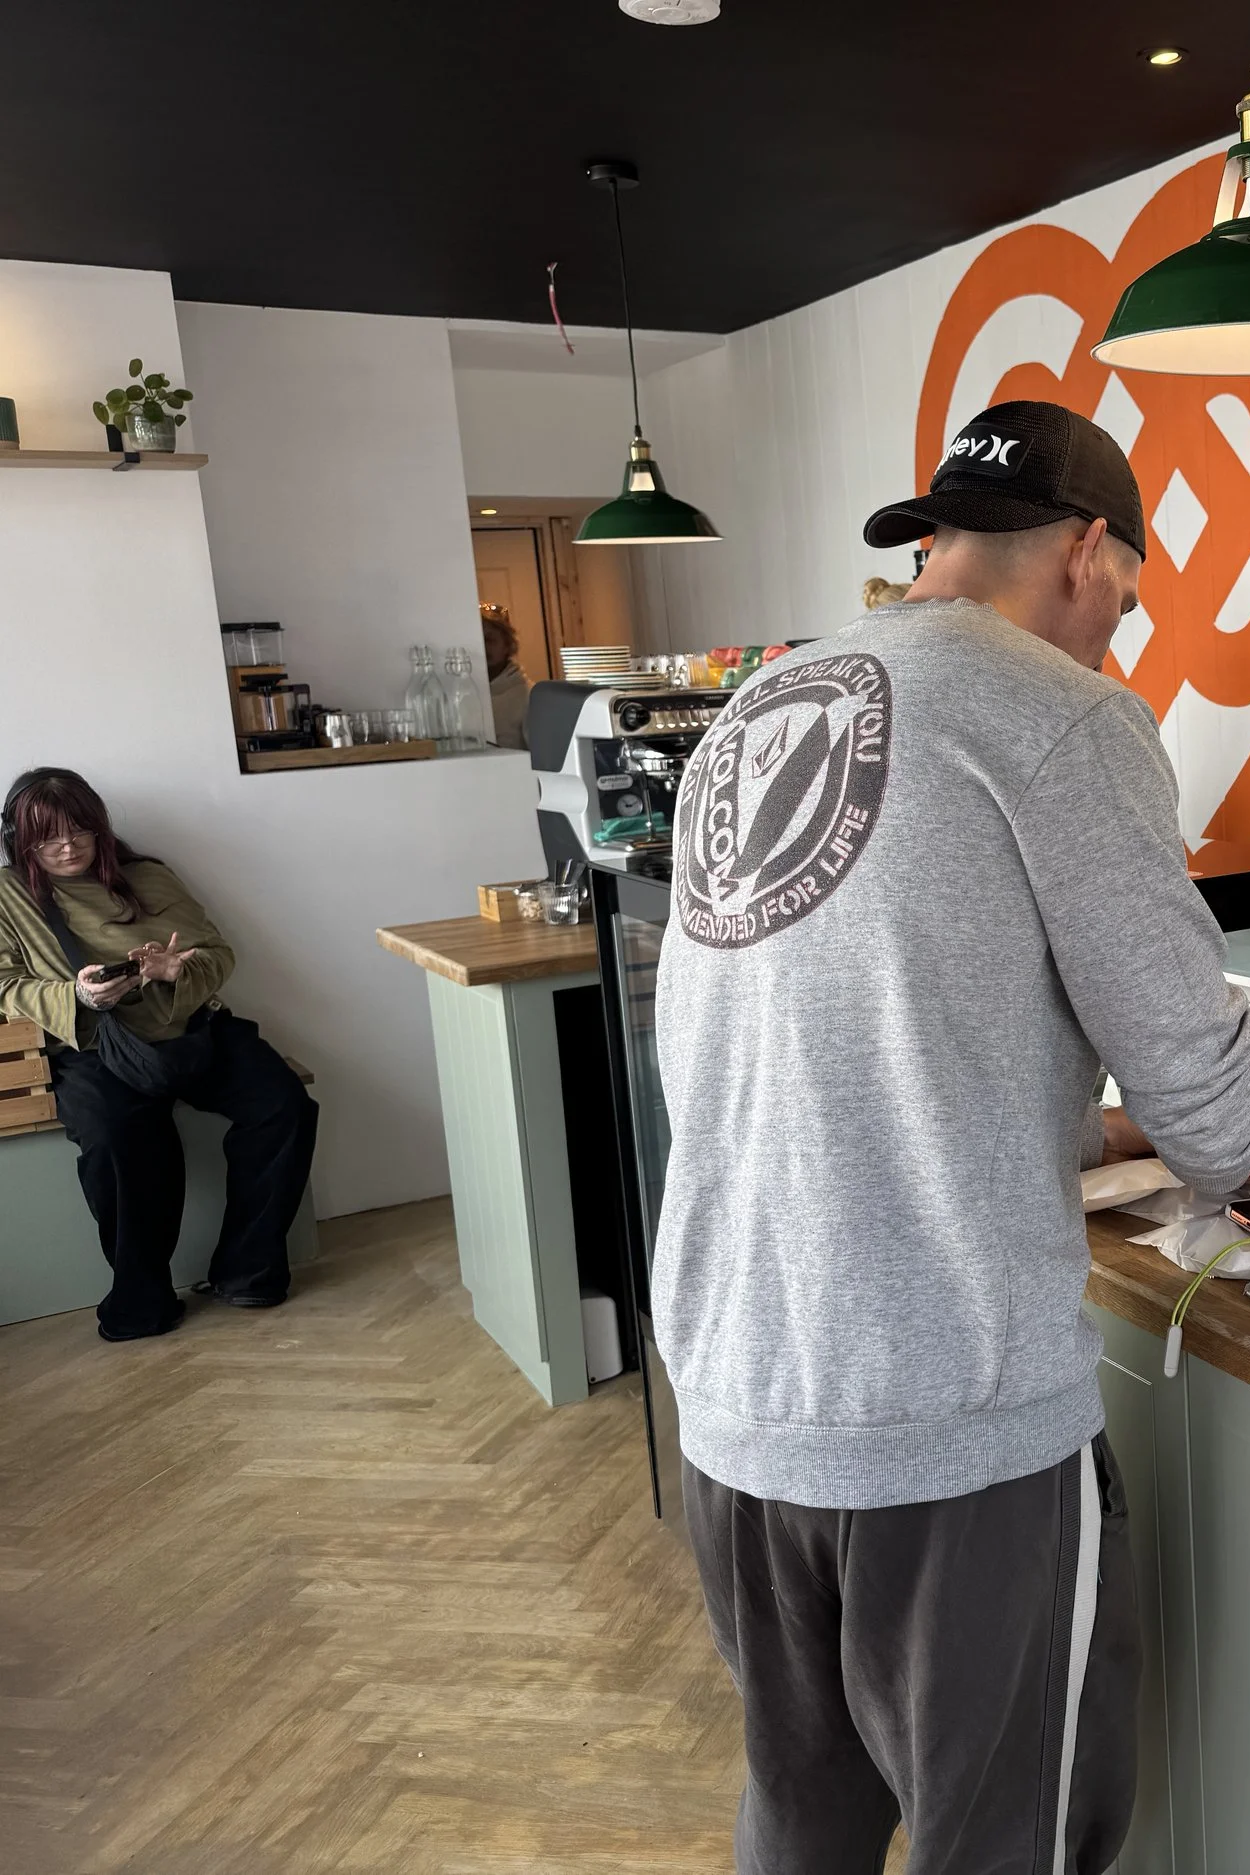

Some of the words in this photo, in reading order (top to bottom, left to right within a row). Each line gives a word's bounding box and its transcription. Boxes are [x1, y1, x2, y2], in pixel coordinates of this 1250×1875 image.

[776, 658, 865, 689] SPEAK
[854, 690, 885, 763] YOU
[706, 718, 747, 903] VOLCOM
[760, 874, 823, 929] FOR
[818, 802, 870, 878] LIFE
